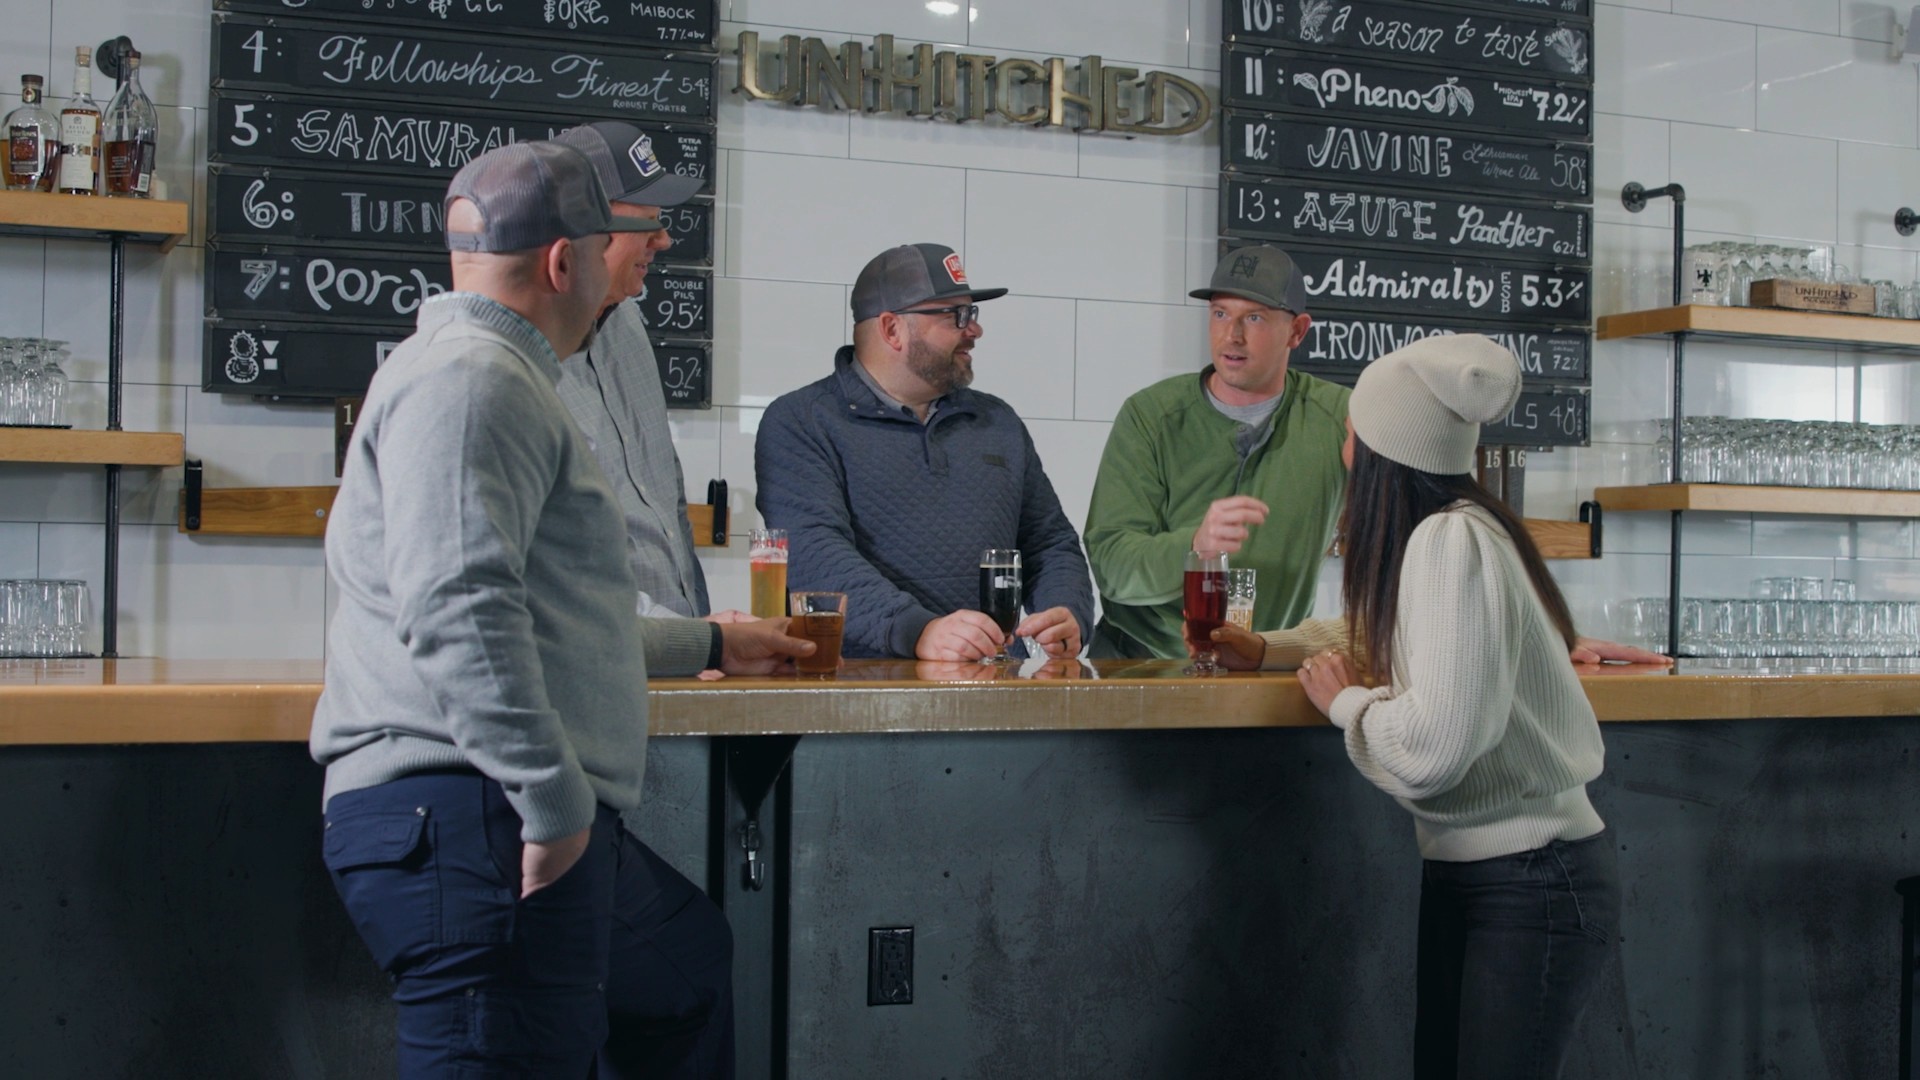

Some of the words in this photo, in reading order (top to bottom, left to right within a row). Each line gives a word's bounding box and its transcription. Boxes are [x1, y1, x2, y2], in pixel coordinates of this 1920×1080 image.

[630, 3, 695, 20] MAIBOCK
[1359, 16, 1444, 53] season
[1455, 17, 1476, 45] to
[1482, 25, 1540, 66] taste
[319, 35, 543, 99] Fellowships
[551, 54, 673, 103] Finest
[737, 30, 1211, 136] UNHITCHED
[612, 100, 648, 110] ROBUST
[652, 103, 687, 113] PORTER
[1321, 69, 1422, 111] Pheno
[1532, 90, 1586, 125] 7.2%
[678, 137, 702, 145] EXTRA
[1307, 126, 1453, 177] JAVINE
[1519, 164, 1541, 180] Ale
[1449, 204, 1555, 249] Panther
[664, 280, 704, 290] DOUBLE
[673, 291, 695, 301] PILS
[1303, 259, 1494, 308] Admiralty
[1520, 274, 1584, 308] 5.3%
[657, 300, 703, 329] 9.5%
[1309, 320, 1457, 361] IRONW
[1485, 450, 1501, 469] 15
[1509, 449, 1526, 468] 16
